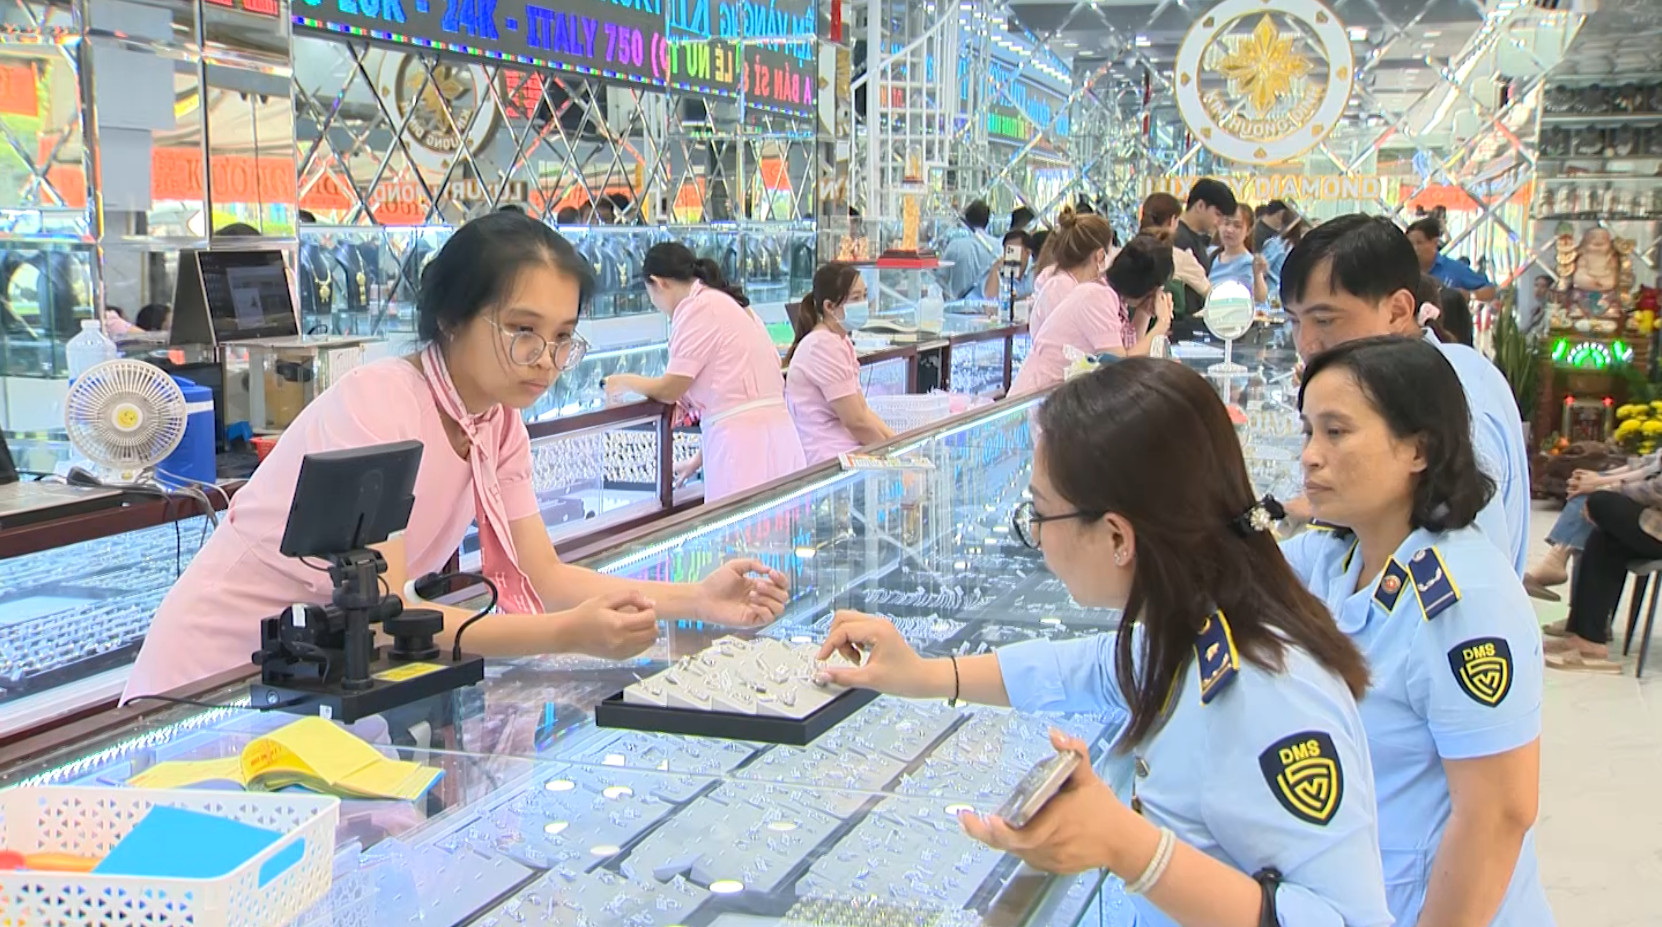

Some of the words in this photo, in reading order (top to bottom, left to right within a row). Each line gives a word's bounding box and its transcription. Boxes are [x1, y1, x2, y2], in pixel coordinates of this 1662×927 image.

[525, 4, 599, 58] ITALY
[604, 22, 644, 67] 750
[1255, 175, 1382, 200] DIAMOND
[1462, 643, 1496, 661] DMS
[1278, 739, 1321, 765] DMS
